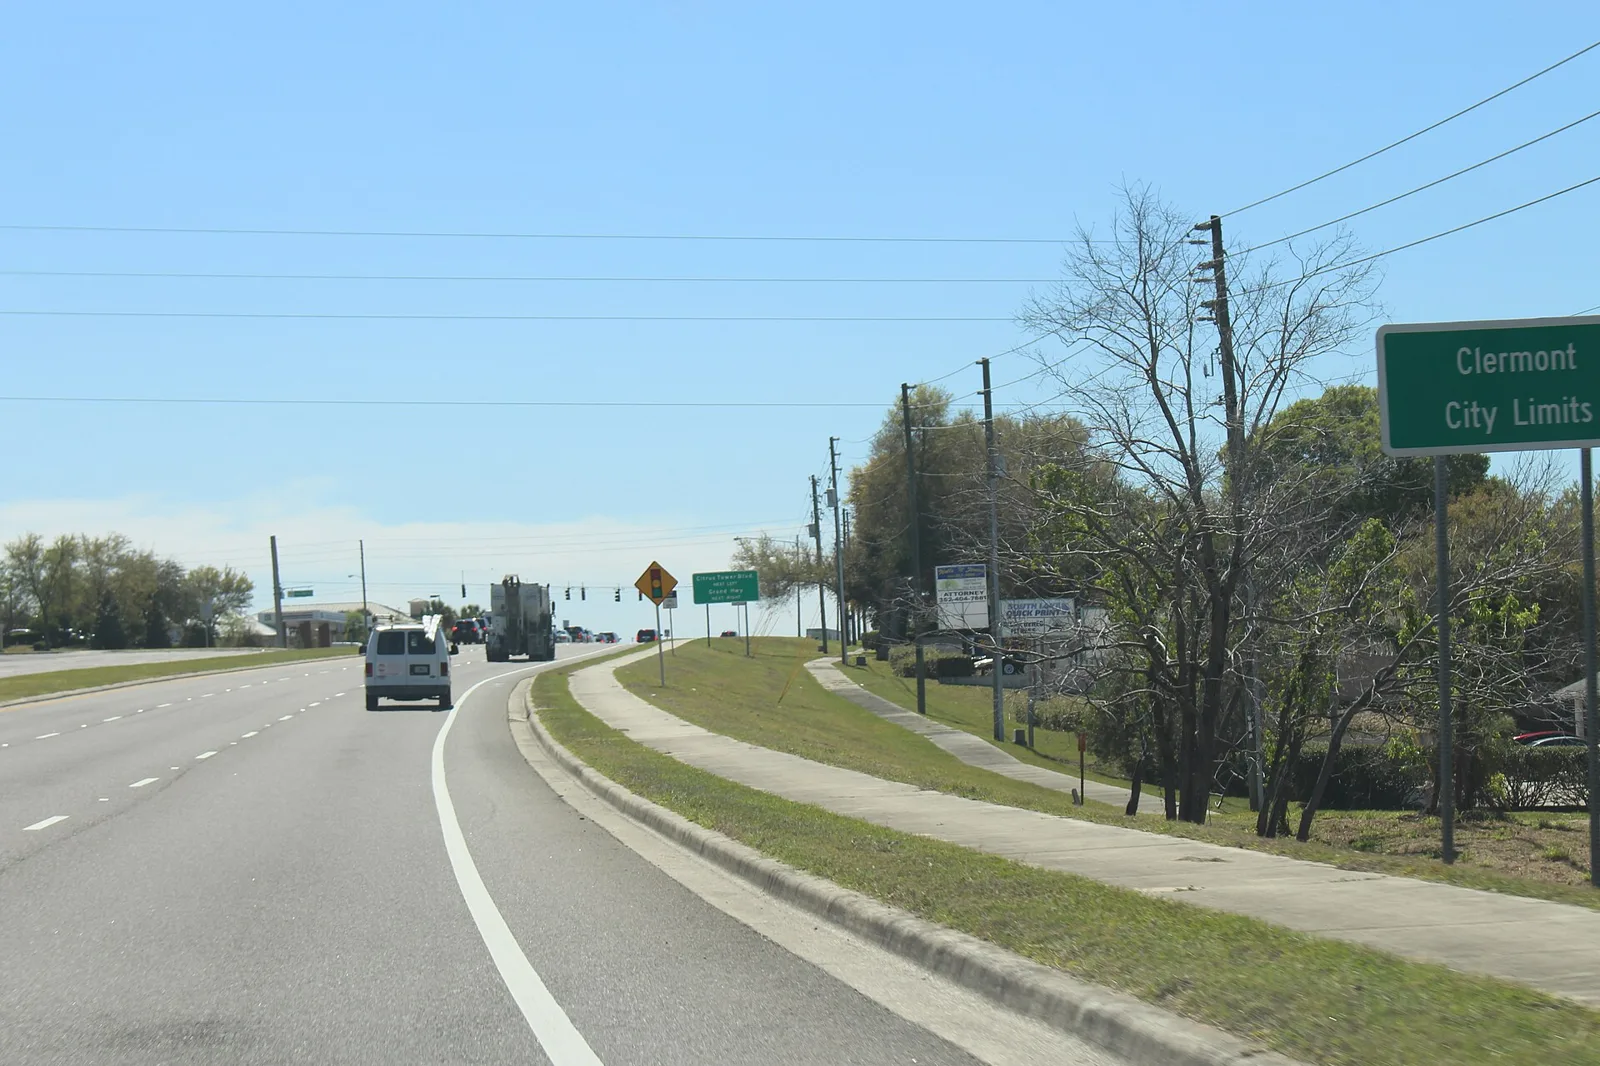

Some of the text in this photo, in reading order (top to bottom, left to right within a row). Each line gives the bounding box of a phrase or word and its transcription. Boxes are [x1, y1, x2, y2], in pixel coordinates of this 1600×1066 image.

[1456, 343, 1578, 375] Clermont
[1445, 396, 1594, 435] City Limits
[1006, 609, 1033, 617] QUICK
